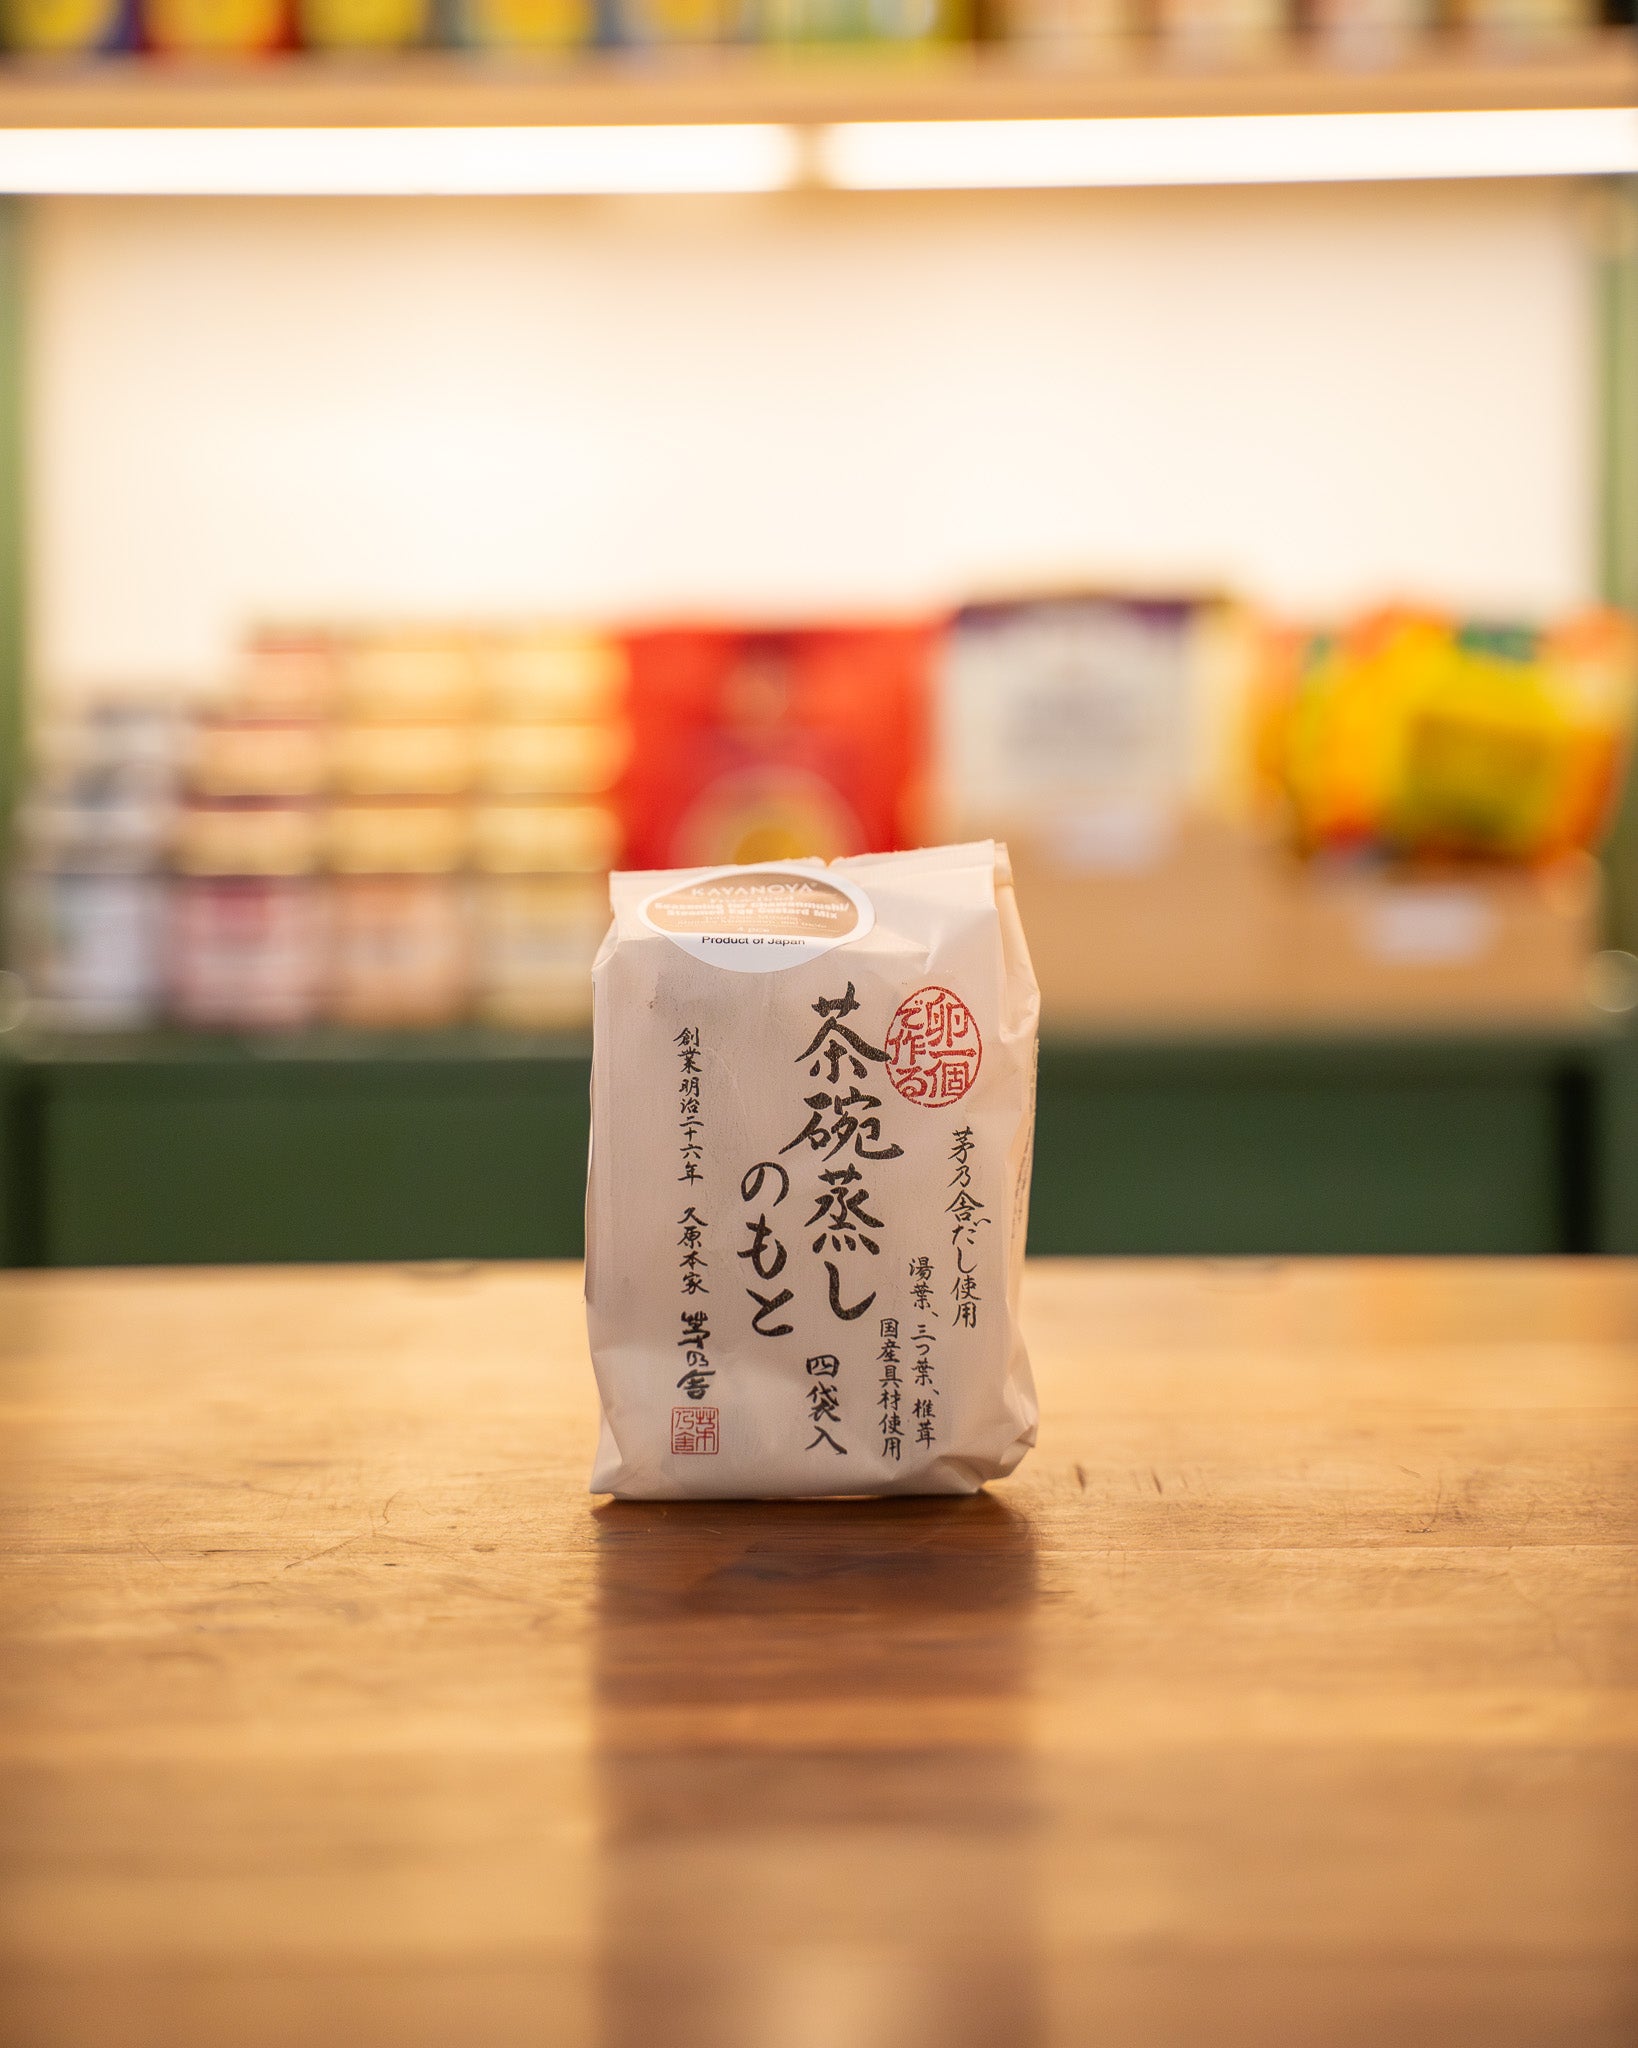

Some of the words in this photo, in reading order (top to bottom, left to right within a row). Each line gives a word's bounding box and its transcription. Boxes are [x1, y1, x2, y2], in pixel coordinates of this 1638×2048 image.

[691, 883, 814, 897] KAYANOYA
[701, 936, 749, 945] Product
[752, 936, 765, 945] of
[767, 936, 806, 947] Japan
[813, 909, 838, 920] Mix
[888, 1000, 928, 1098] で作る
[924, 993, 977, 1098] 卵一個
[673, 1027, 704, 1187] 創業明治二十六年
[778, 980, 904, 1323] 茶碗蒸し
[677, 1206, 710, 1297] 久原本家
[736, 1161, 795, 1338] のもと
[945, 1125, 992, 1329] 茅乃舎だし使用
[805, 1354, 848, 1456] 四袋入
[876, 1317, 905, 1462] 国産具材使用
[909, 1256, 940, 1450] 湯葉、三つ葉、椎茸
